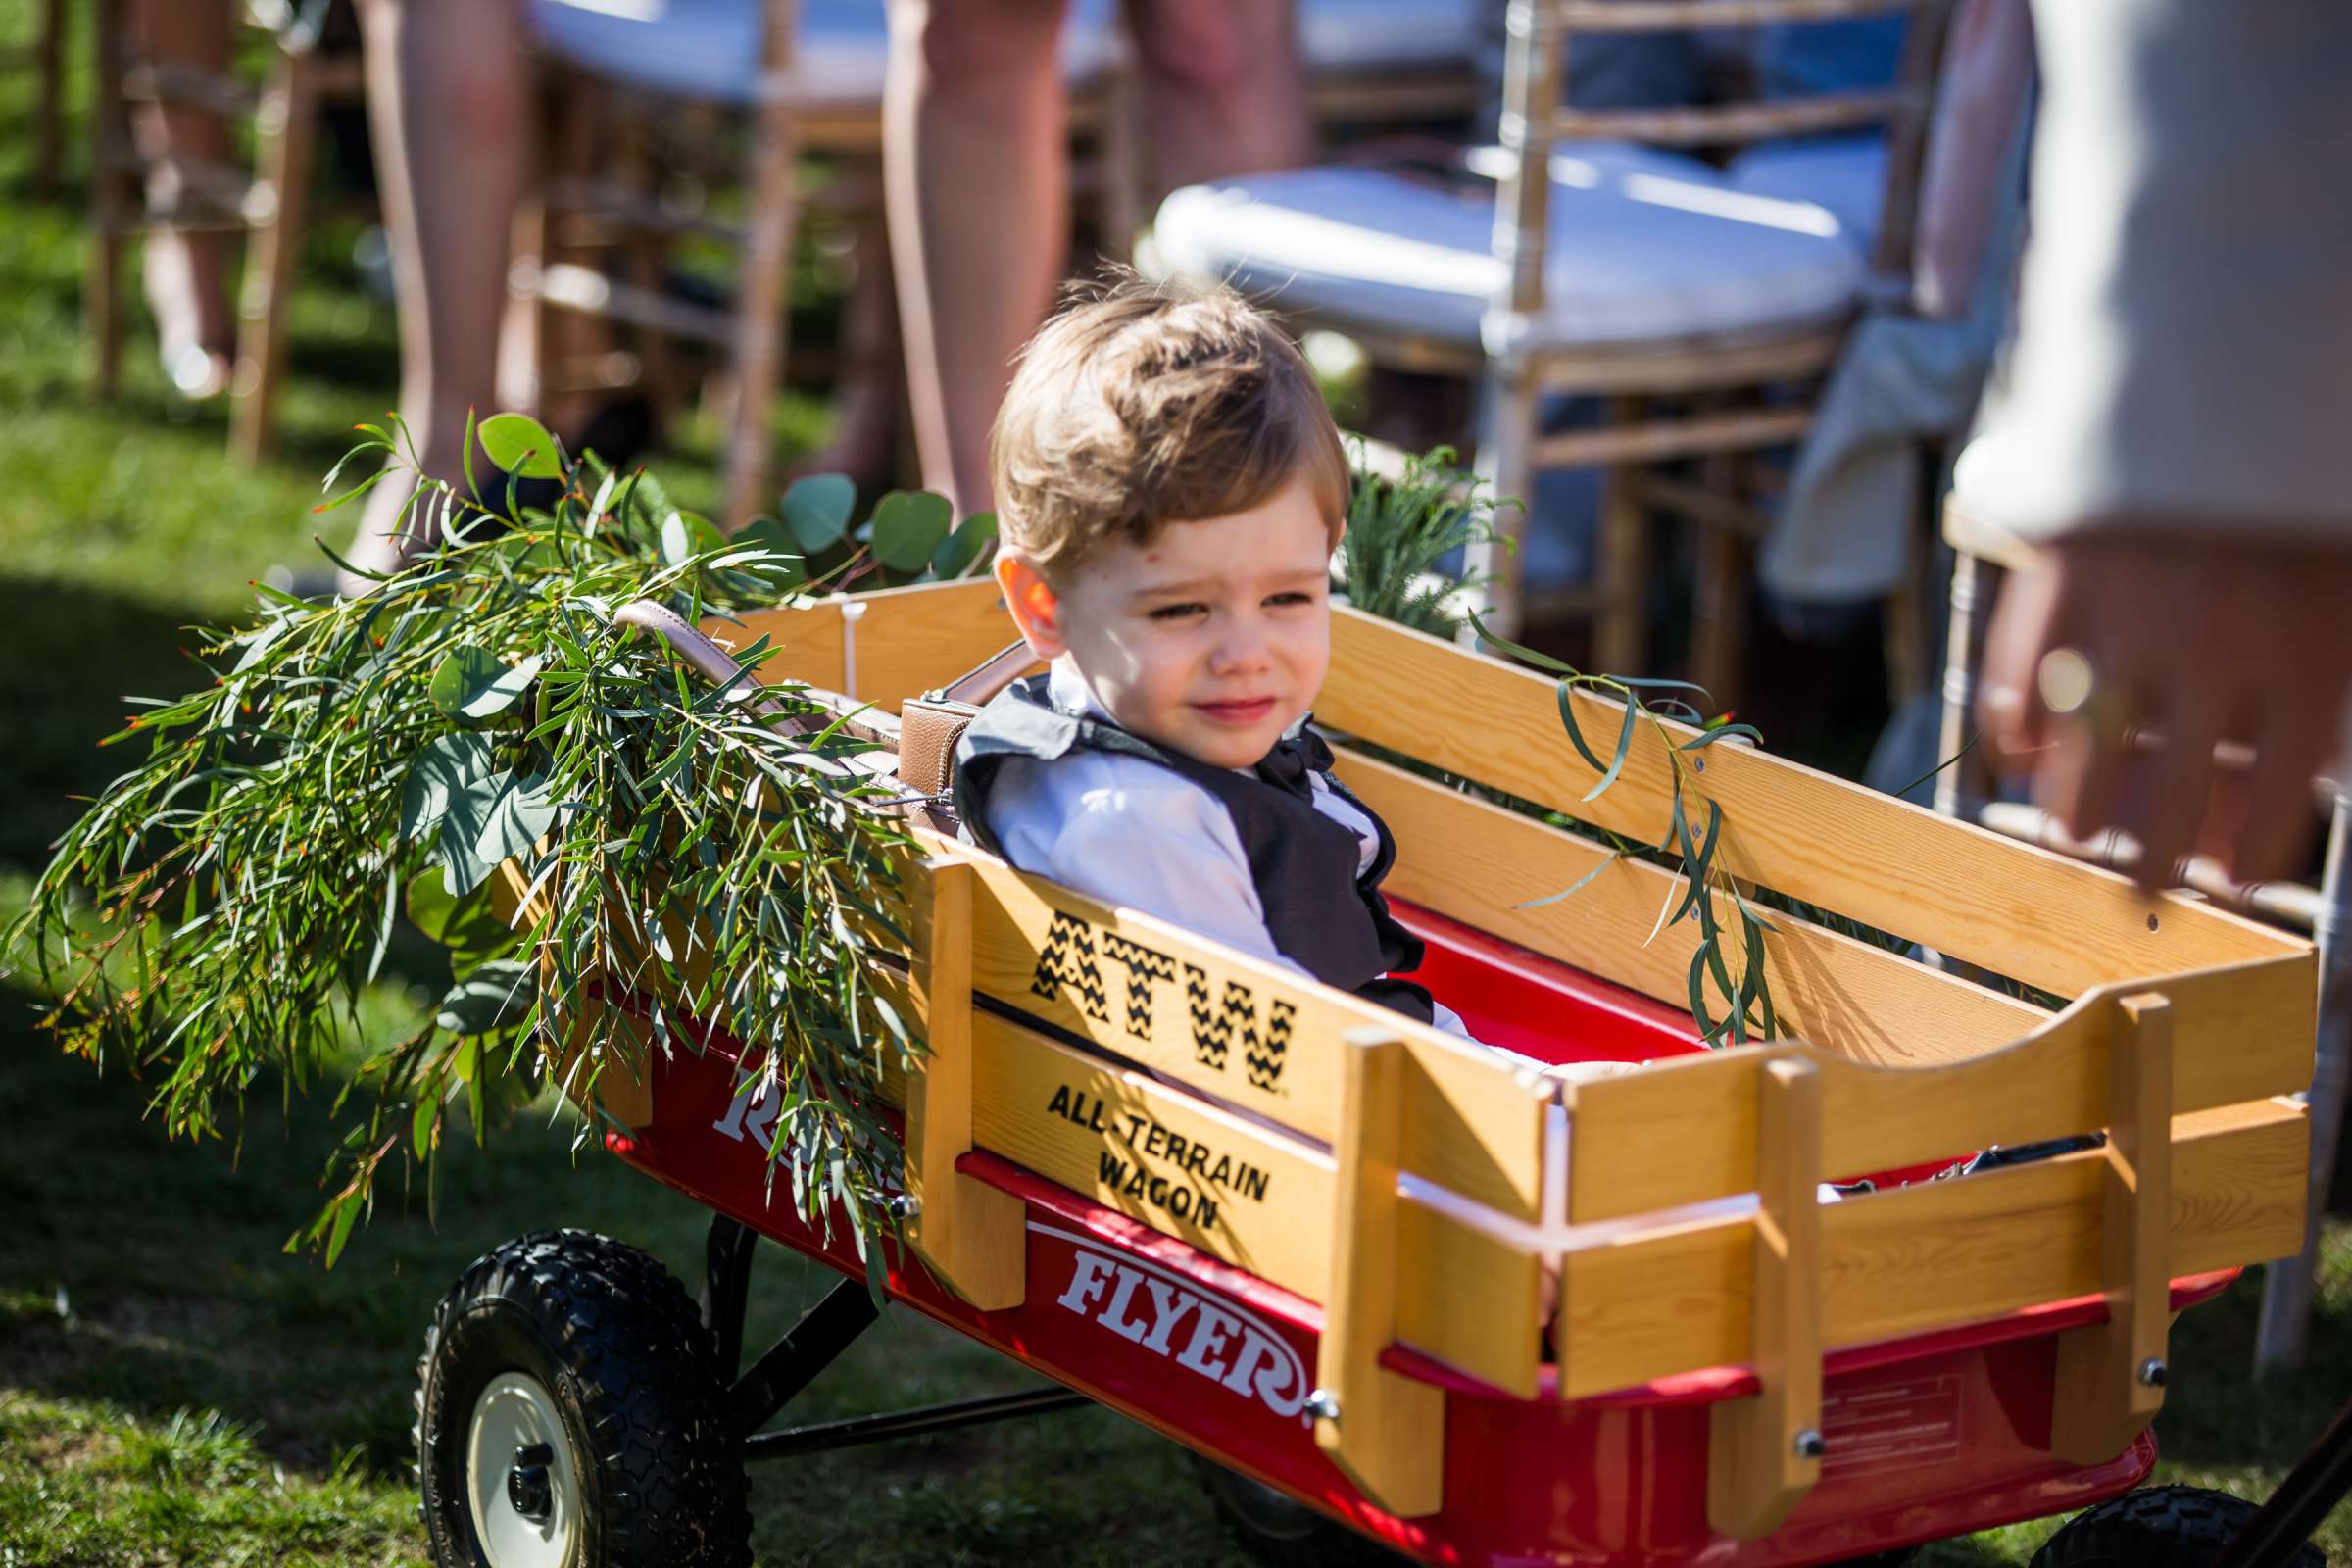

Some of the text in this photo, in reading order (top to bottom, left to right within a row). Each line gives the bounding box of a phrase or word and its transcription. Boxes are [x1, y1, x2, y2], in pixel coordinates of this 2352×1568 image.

[1030, 909, 1298, 1094] ATW
[1099, 1152, 1219, 1230] WAGON
[1057, 1250, 1307, 1417] FLYER
